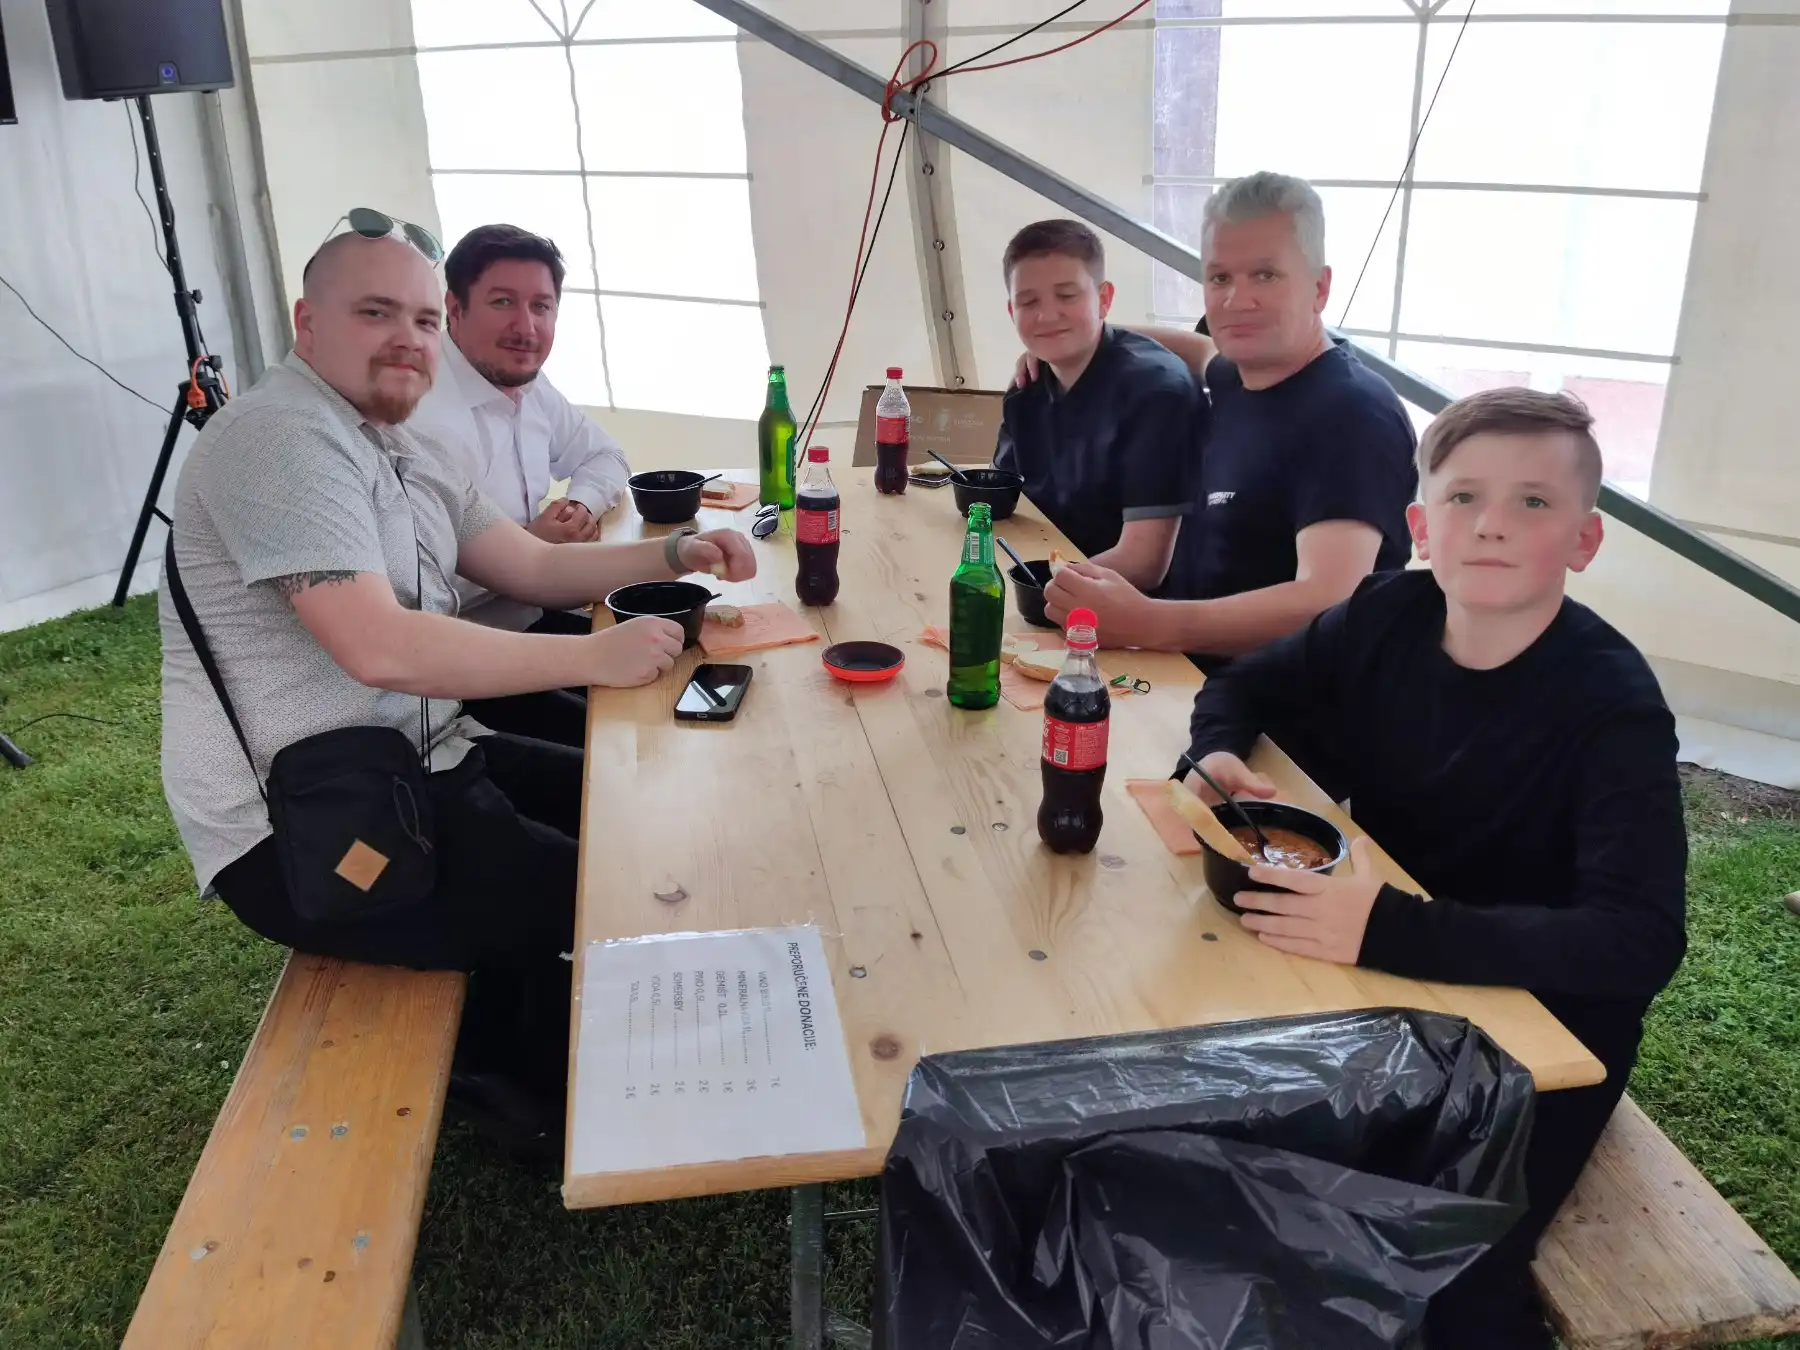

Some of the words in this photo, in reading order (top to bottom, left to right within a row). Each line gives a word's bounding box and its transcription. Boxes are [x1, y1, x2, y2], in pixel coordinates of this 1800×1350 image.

[673, 971, 684, 1011] SOMERSBY
[787, 942, 809, 998] PREPORUČENE
[798, 1000, 817, 1051] DONACIJE:
